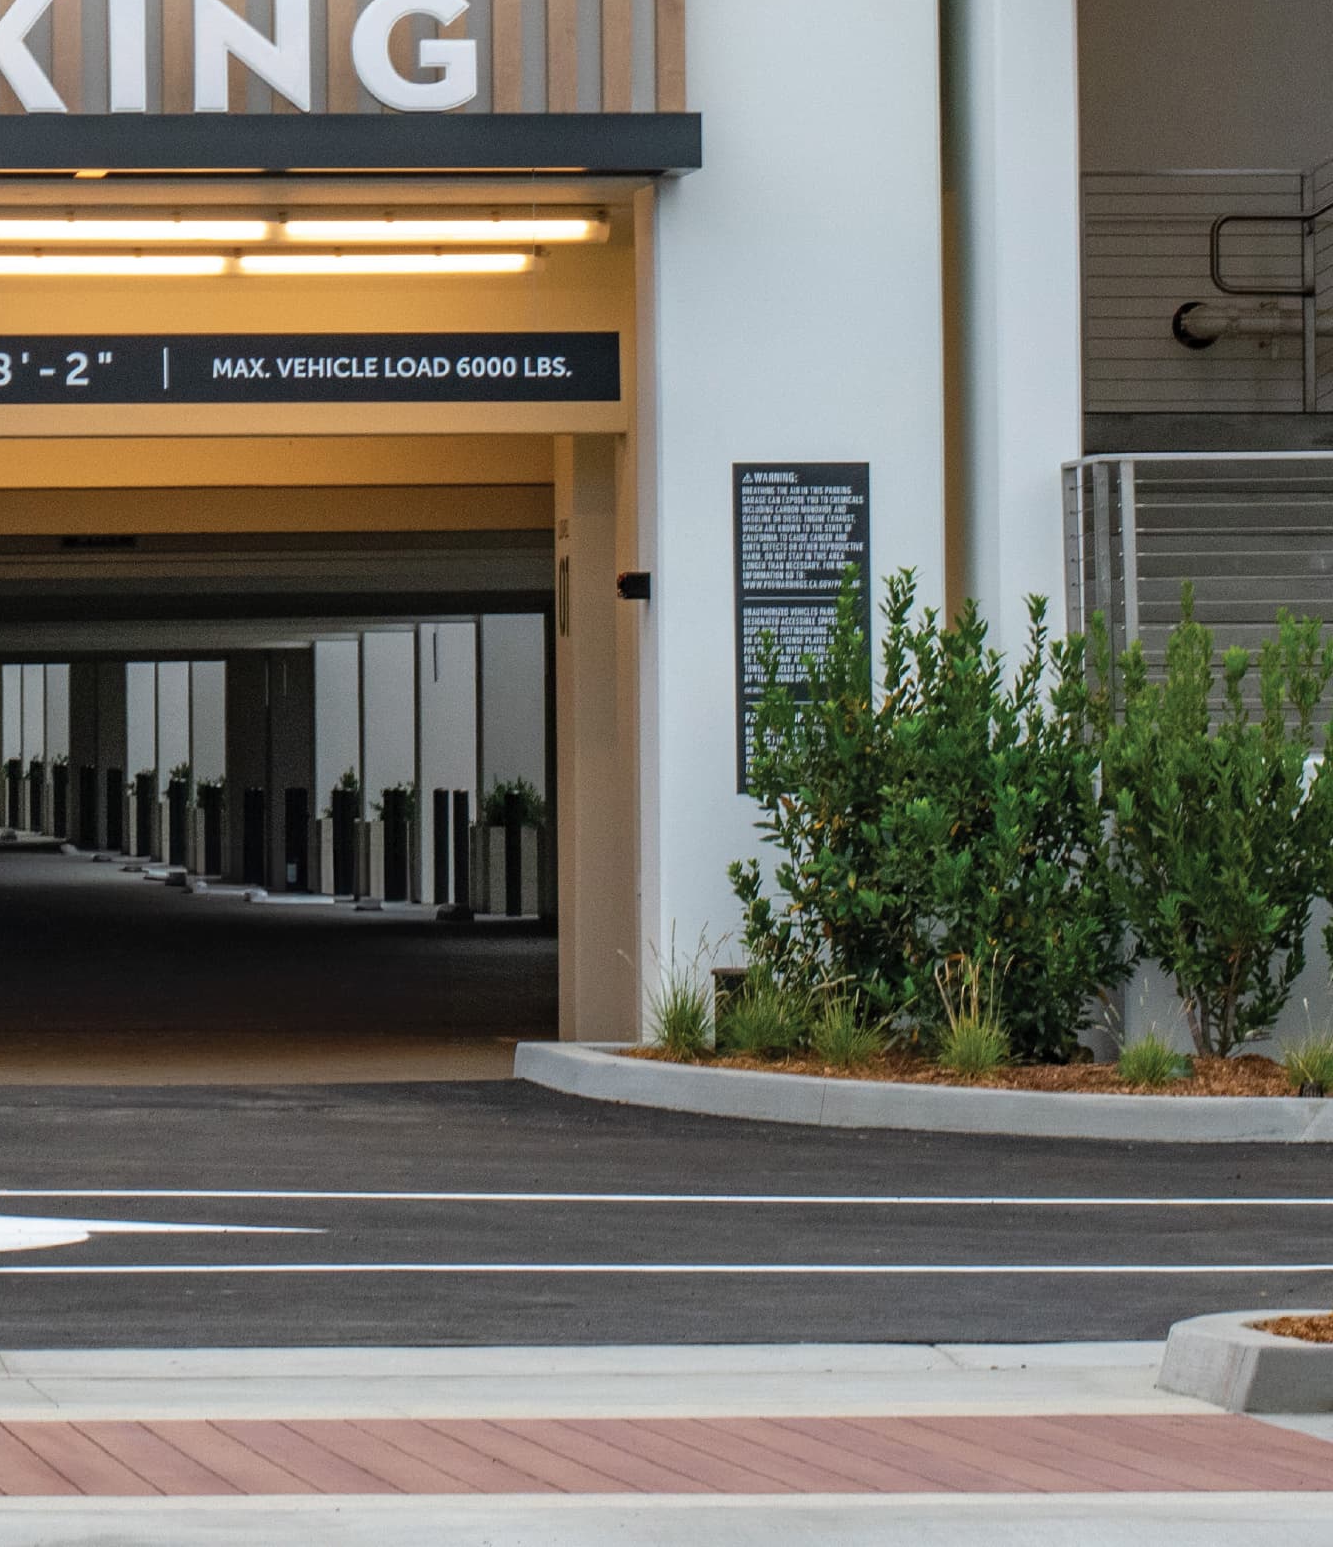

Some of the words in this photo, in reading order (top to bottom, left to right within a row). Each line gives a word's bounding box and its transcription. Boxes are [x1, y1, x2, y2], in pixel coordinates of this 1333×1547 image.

[212, 357, 271, 379] MAX.
[276, 357, 379, 378] VEHICLE
[384, 356, 451, 378] LOAD
[456, 356, 517, 378] 6000
[524, 356, 572, 378] LBS.
[754, 472, 798, 483] WARNING:
